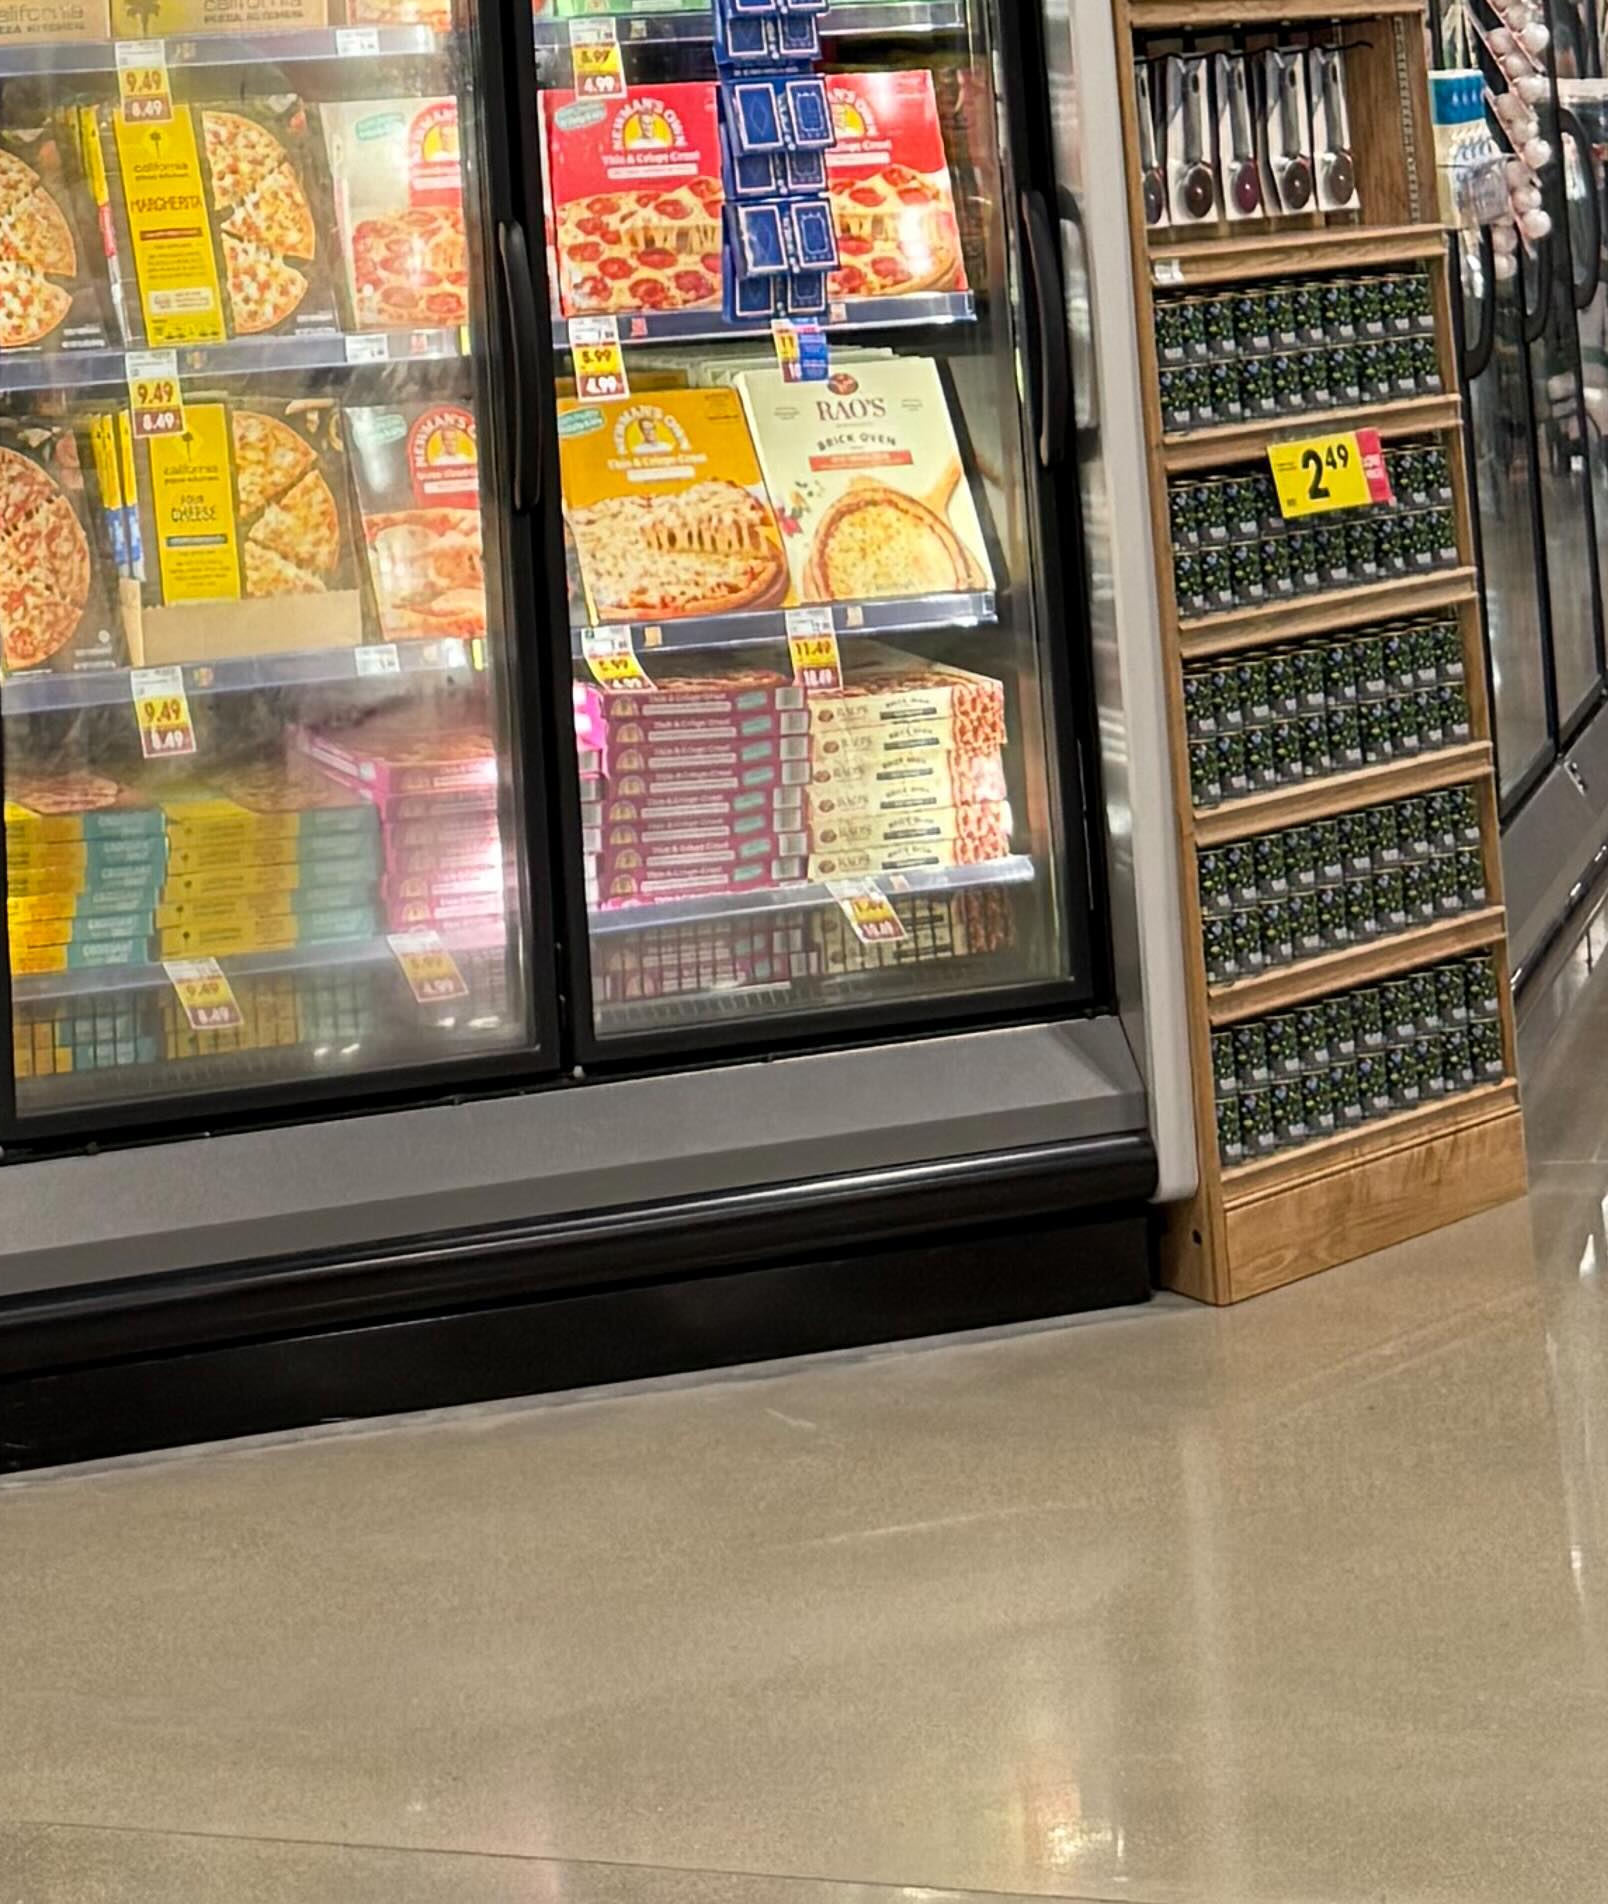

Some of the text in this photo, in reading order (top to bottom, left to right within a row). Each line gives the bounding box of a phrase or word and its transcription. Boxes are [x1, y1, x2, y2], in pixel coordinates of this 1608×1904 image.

[126, 71, 162, 92] 9.49
[584, 76, 615, 92] 4.99
[611, 97, 665, 151] NEWMAN'S
[664, 109, 688, 147] OWN
[132, 161, 189, 174] california
[130, 195, 203, 213] MARGHERITA
[582, 349, 612, 363] 5.99
[586, 375, 617, 392] 4.99
[137, 383, 175, 405] 9.49
[816, 397, 886, 421] RAO'S
[142, 413, 176, 431] 8.49
[416, 413, 467, 467] NEWMAN'S
[817, 433, 896, 451] BRICK OVEN
[163, 464, 219, 476] california
[171, 506, 217, 523] CHEESE
[143, 699, 183, 722] 9.49
